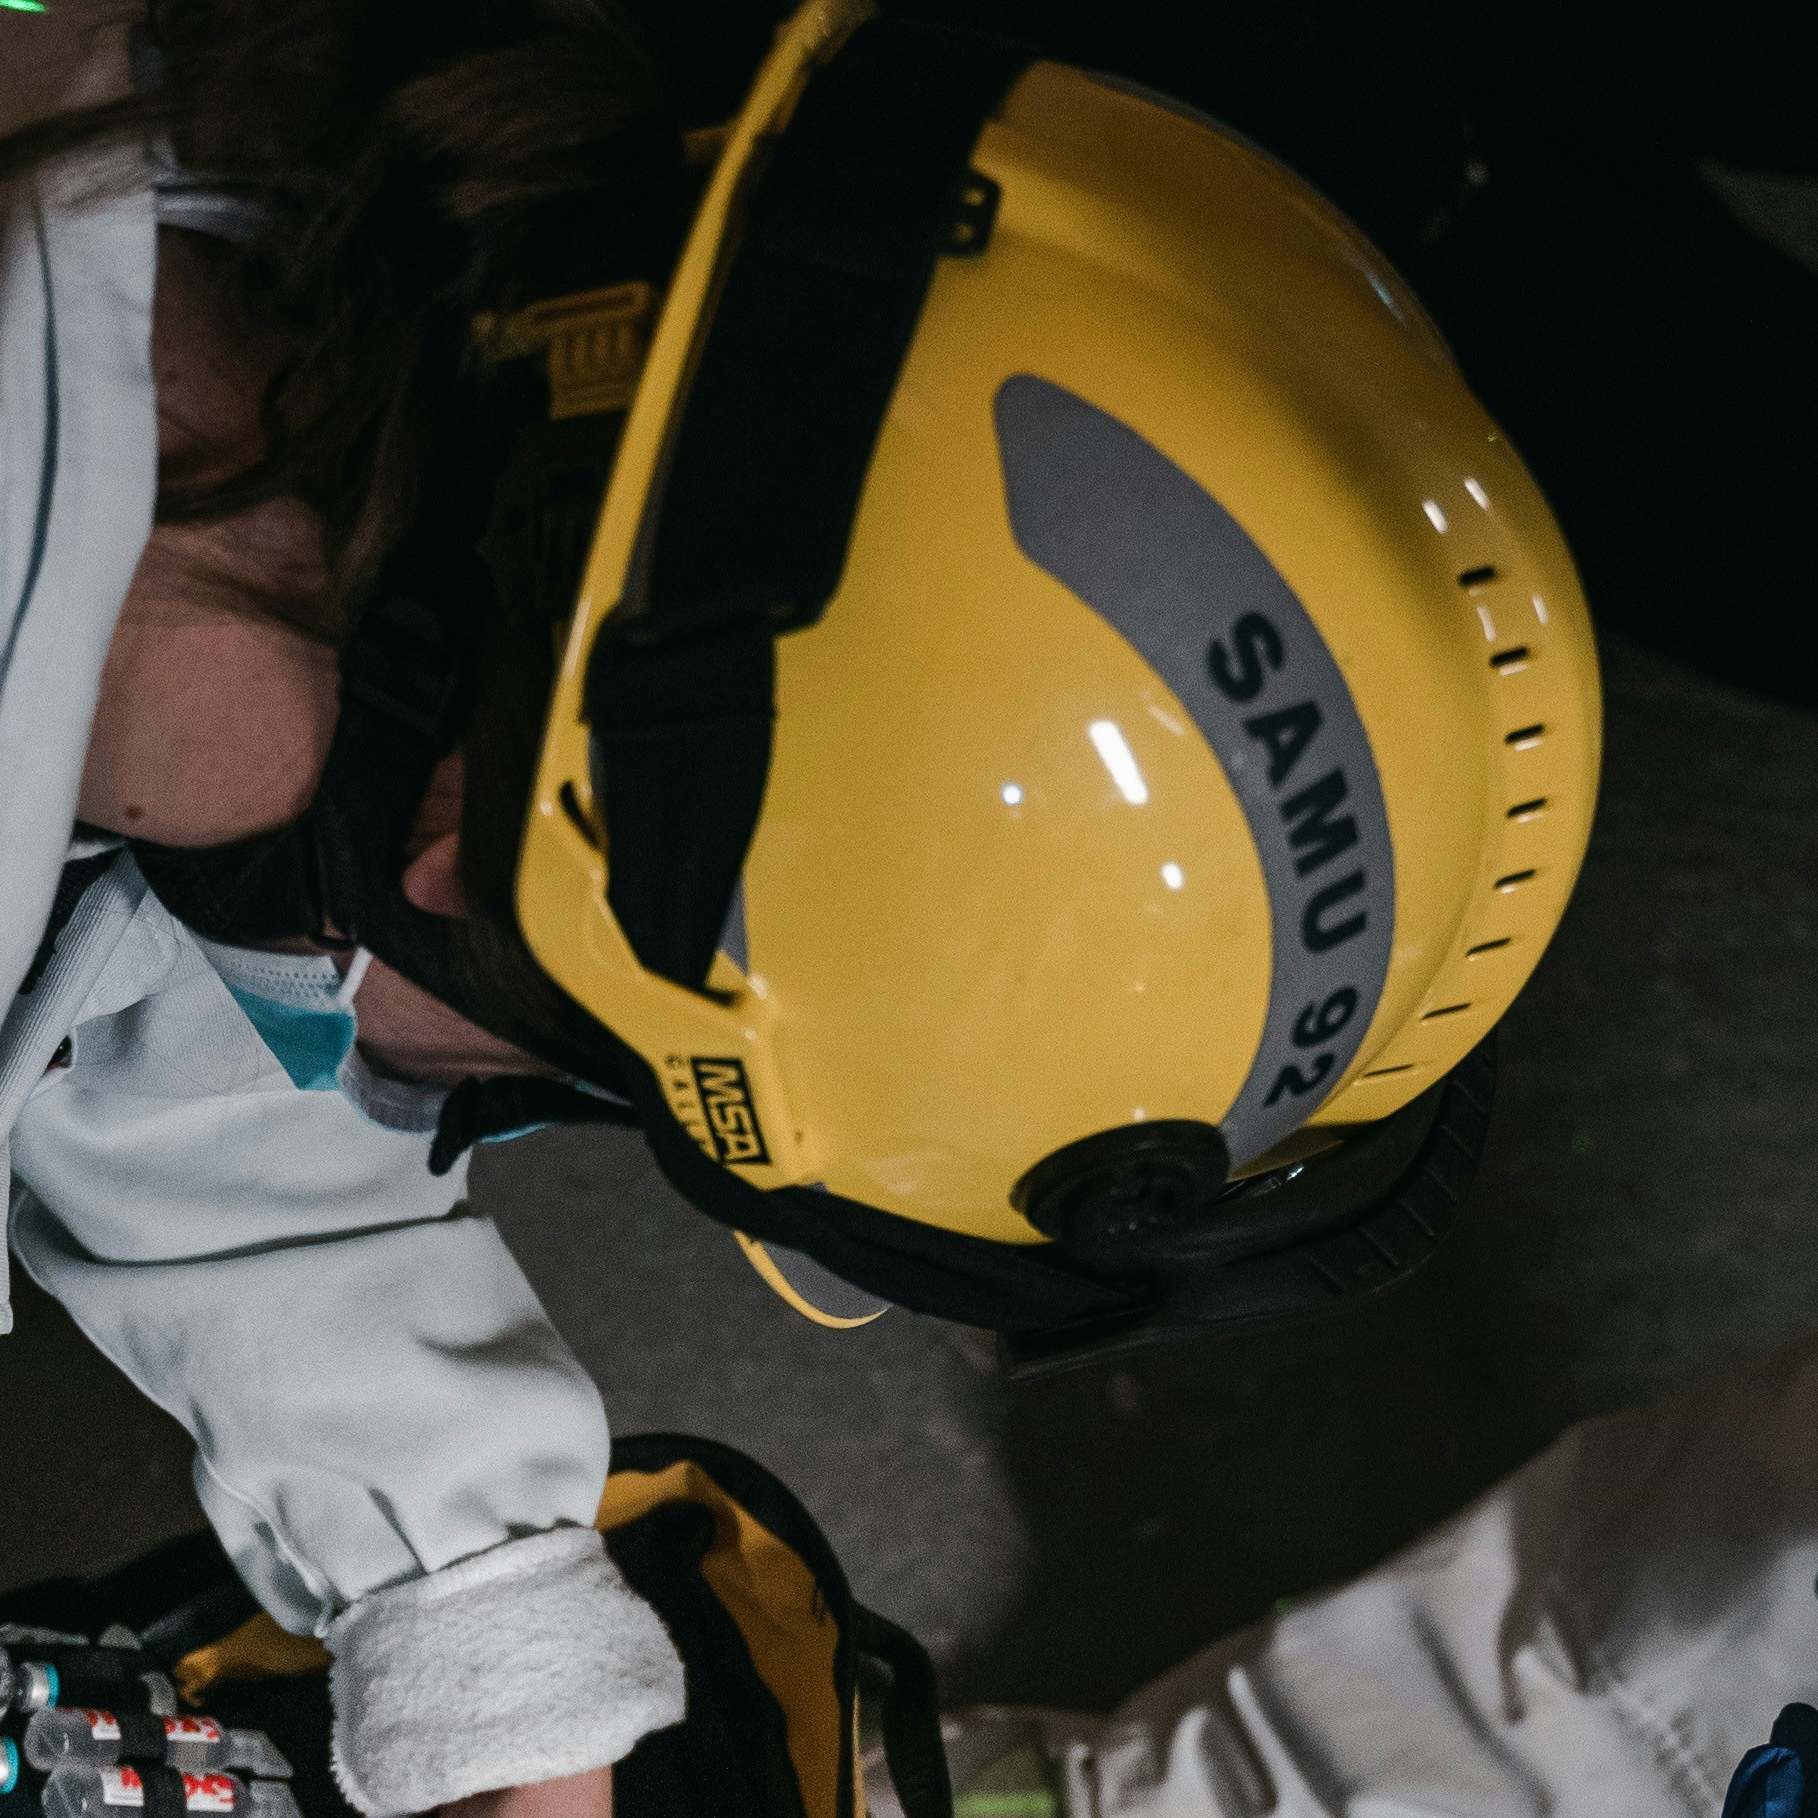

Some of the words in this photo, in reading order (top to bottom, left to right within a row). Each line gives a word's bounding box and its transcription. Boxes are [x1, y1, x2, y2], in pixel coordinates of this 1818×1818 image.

[1205, 610, 1368, 955] SAMU
[697, 1065, 760, 1159] MSA
[1263, 984, 1361, 1112] 92
